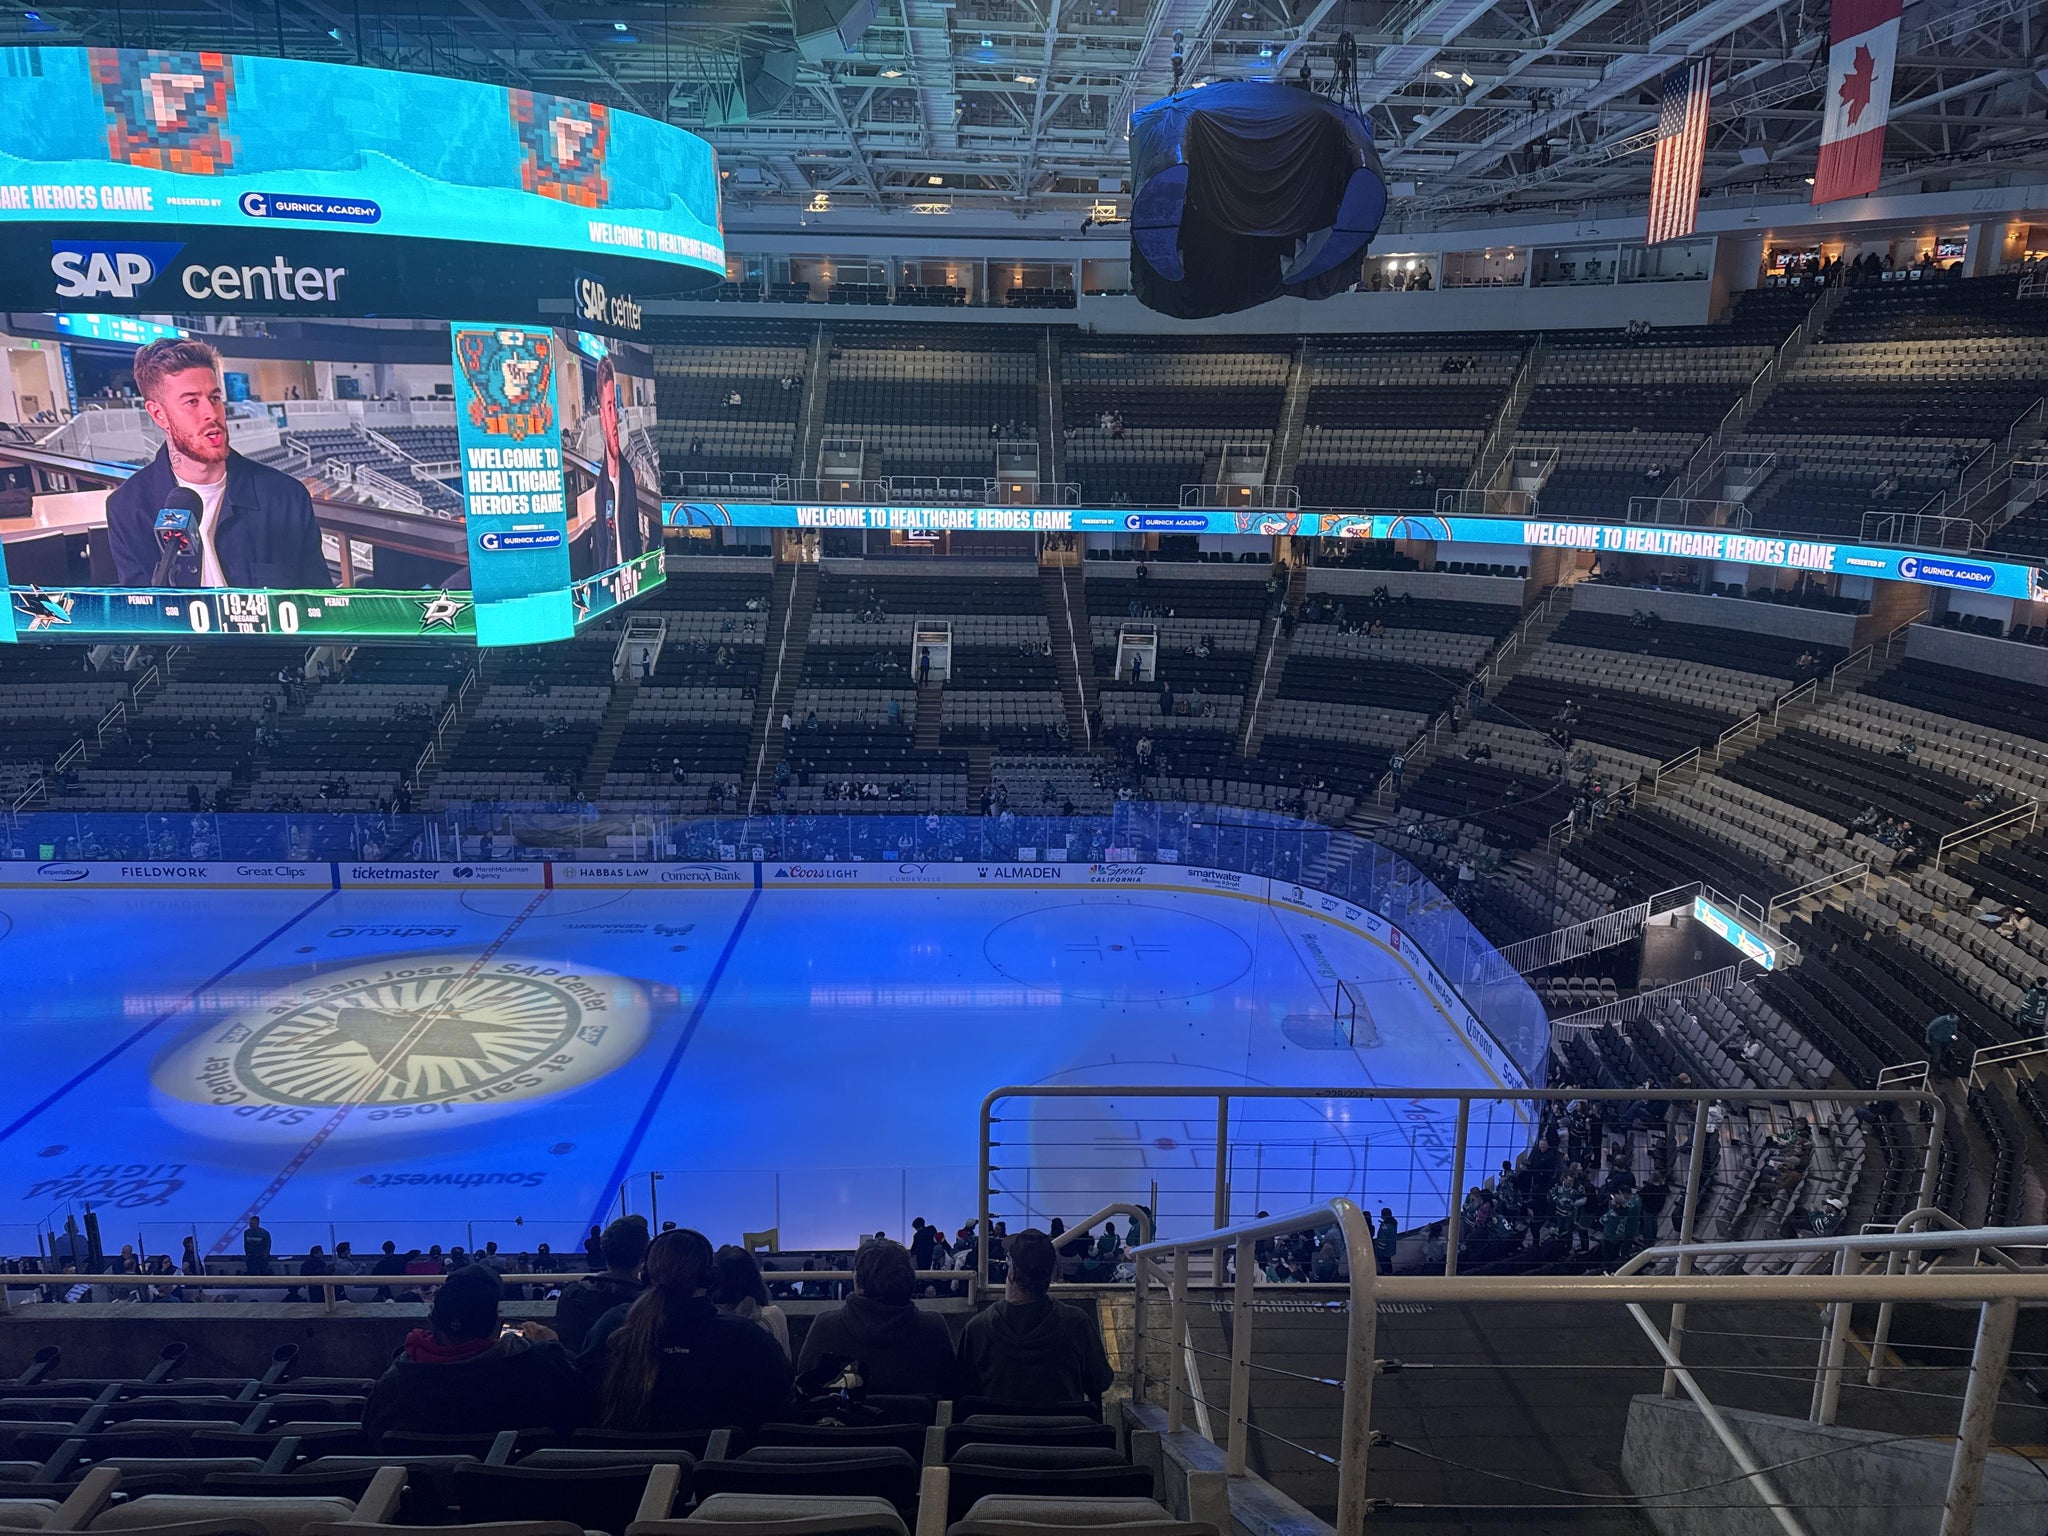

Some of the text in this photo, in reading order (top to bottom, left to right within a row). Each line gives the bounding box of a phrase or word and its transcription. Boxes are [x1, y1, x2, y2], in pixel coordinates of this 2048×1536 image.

[32, 186, 98, 210] HEROES
[100, 186, 154, 211] GAME
[275, 201, 376, 217] GURNICK ACADEMY
[588, 221, 645, 249] WELCOME
[645, 229, 658, 251] TO
[51, 251, 345, 301] SAP center
[582, 279, 642, 330] SAP center
[467, 448, 559, 469] WELCOME TO
[467, 470, 562, 493] HEALTHCARE
[469, 493, 564, 515] HEROES GAME
[796, 508, 1072, 530] WELCOME TO HEALTHCARE HEROES GAME
[1145, 519, 1206, 527] GURNICK ACADEMY
[503, 537, 534, 545] GURNICK
[1523, 523, 1837, 569] WELCOME TO HEALTHCARE HEROES GAME
[1922, 566, 1992, 583] GURNICK ACADEMY
[128, 595, 153, 605] PENALTY
[222, 593, 267, 615] 19:48
[324, 597, 349, 607] PENALTY
[189, 600, 210, 632] 0
[230, 615, 259, 623] PREGAME
[278, 601, 298, 634] 0
[121, 867, 207, 878] FIELDWORK
[236, 866, 305, 879] Great Clips
[352, 866, 440, 880] ticketmaster
[580, 868, 649, 877] HABBAS LAW
[714, 871, 741, 881] Bank
[789, 865, 859, 879] Coors LIGHT
[994, 867, 1061, 878] ALMADEN
[1105, 863, 1147, 877] Sports
[1187, 869, 1242, 882] smartwater
[1401, 941, 1420, 968] TOYOTA
[267, 965, 455, 1015] at San Jose
[496, 963, 608, 1012] SAP Center
[1433, 977, 1453, 1008] NetApp
[1466, 1015, 1493, 1060] Corona
[196, 1056, 314, 1126] SAP Center
[368, 1054, 574, 1121] at San Jose
[61, 1163, 187, 1179] LIGHT
[376, 1172, 547, 1189] Southwest
[22, 1178, 185, 1209] Coors
[1252, 1300, 1325, 1313] TANDING
